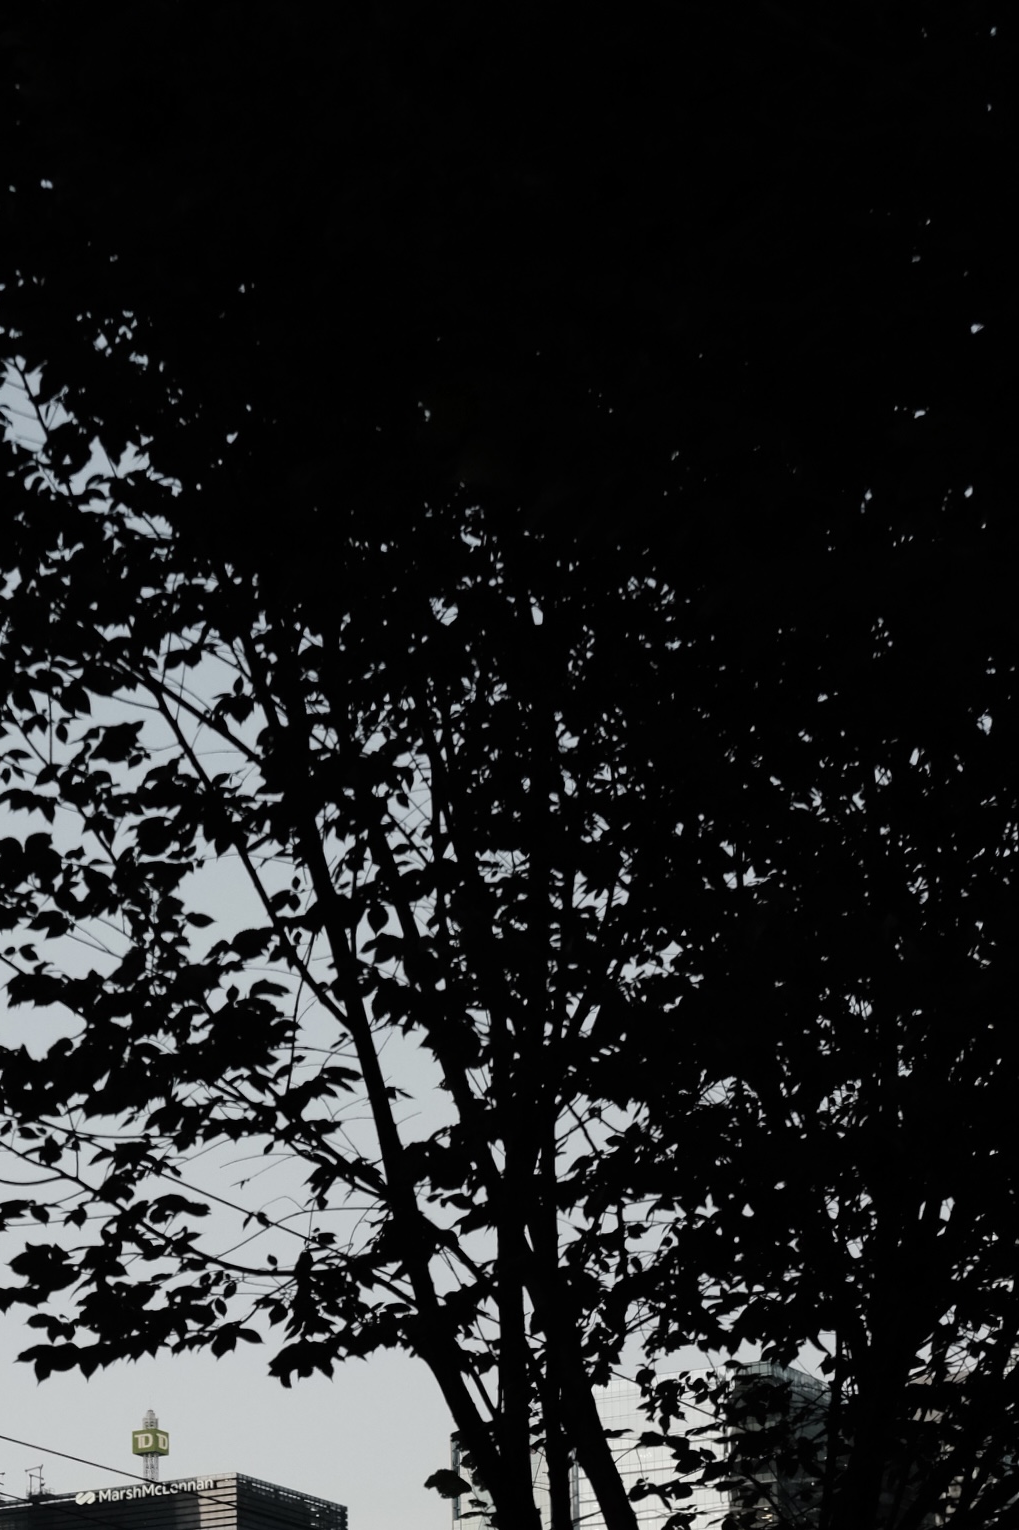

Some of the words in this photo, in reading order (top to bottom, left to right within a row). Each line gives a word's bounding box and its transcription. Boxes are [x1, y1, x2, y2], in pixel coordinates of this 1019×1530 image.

[134, 1432, 153, 1449] TD
[156, 1432, 168, 1450] TD
[98, 1479, 214, 1503] MarshMcLennan
